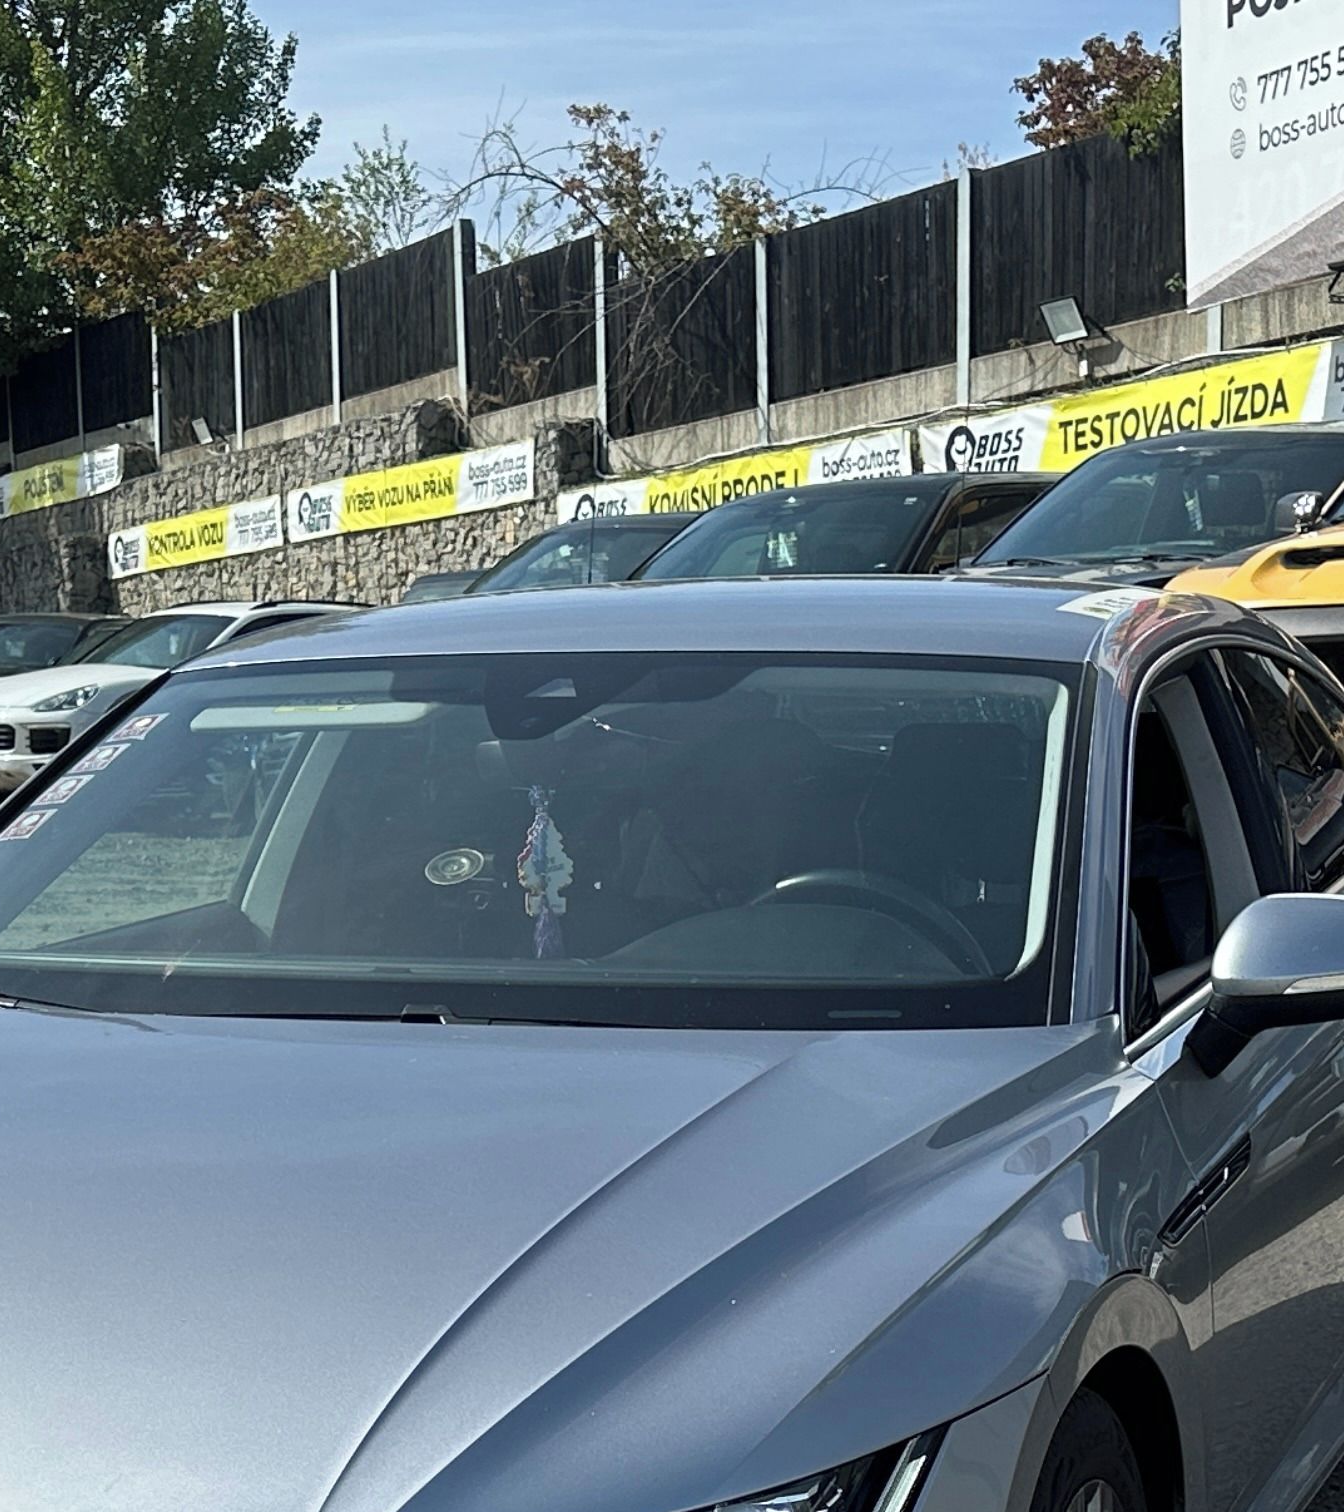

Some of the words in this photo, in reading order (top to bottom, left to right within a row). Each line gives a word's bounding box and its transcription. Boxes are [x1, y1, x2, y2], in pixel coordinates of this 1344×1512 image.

[1257, 66, 1292, 104] 777
[1297, 52, 1332, 90] 755
[1058, 382, 1207, 455] TESTOVACÍ
[1210, 376, 1290, 430] JÍZDA
[976, 427, 1024, 458] BOSS
[468, 454, 527, 481] boss-auto.cz
[822, 449, 901, 479] boss-auto.cz
[378, 484, 405, 508] VOZU
[406, 482, 421, 502] NA
[197, 521, 225, 548] VOZU
